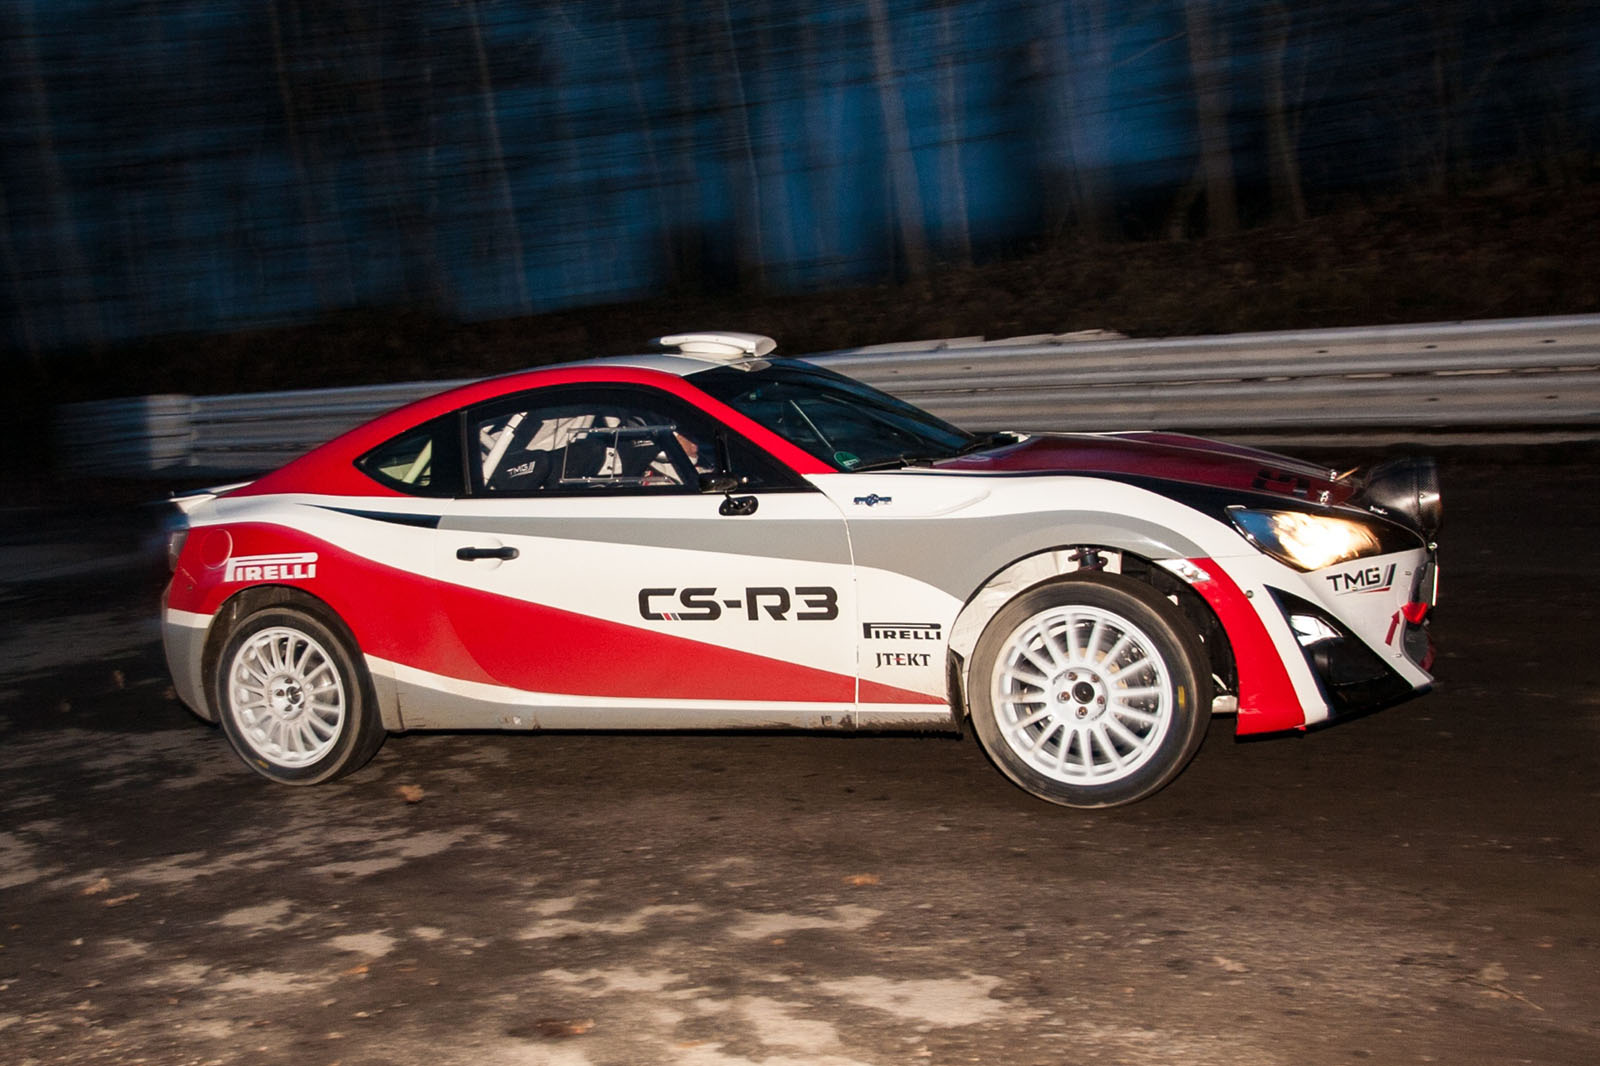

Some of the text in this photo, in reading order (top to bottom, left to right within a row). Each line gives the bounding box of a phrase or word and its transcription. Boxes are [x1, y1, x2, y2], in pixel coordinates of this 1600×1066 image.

[224, 552, 318, 582] PIRELLI
[1326, 567, 1381, 592] TMG
[638, 587, 839, 621] CS-R3
[863, 622, 941, 640] PIRELLI
[875, 653, 931, 668] JTEKT
